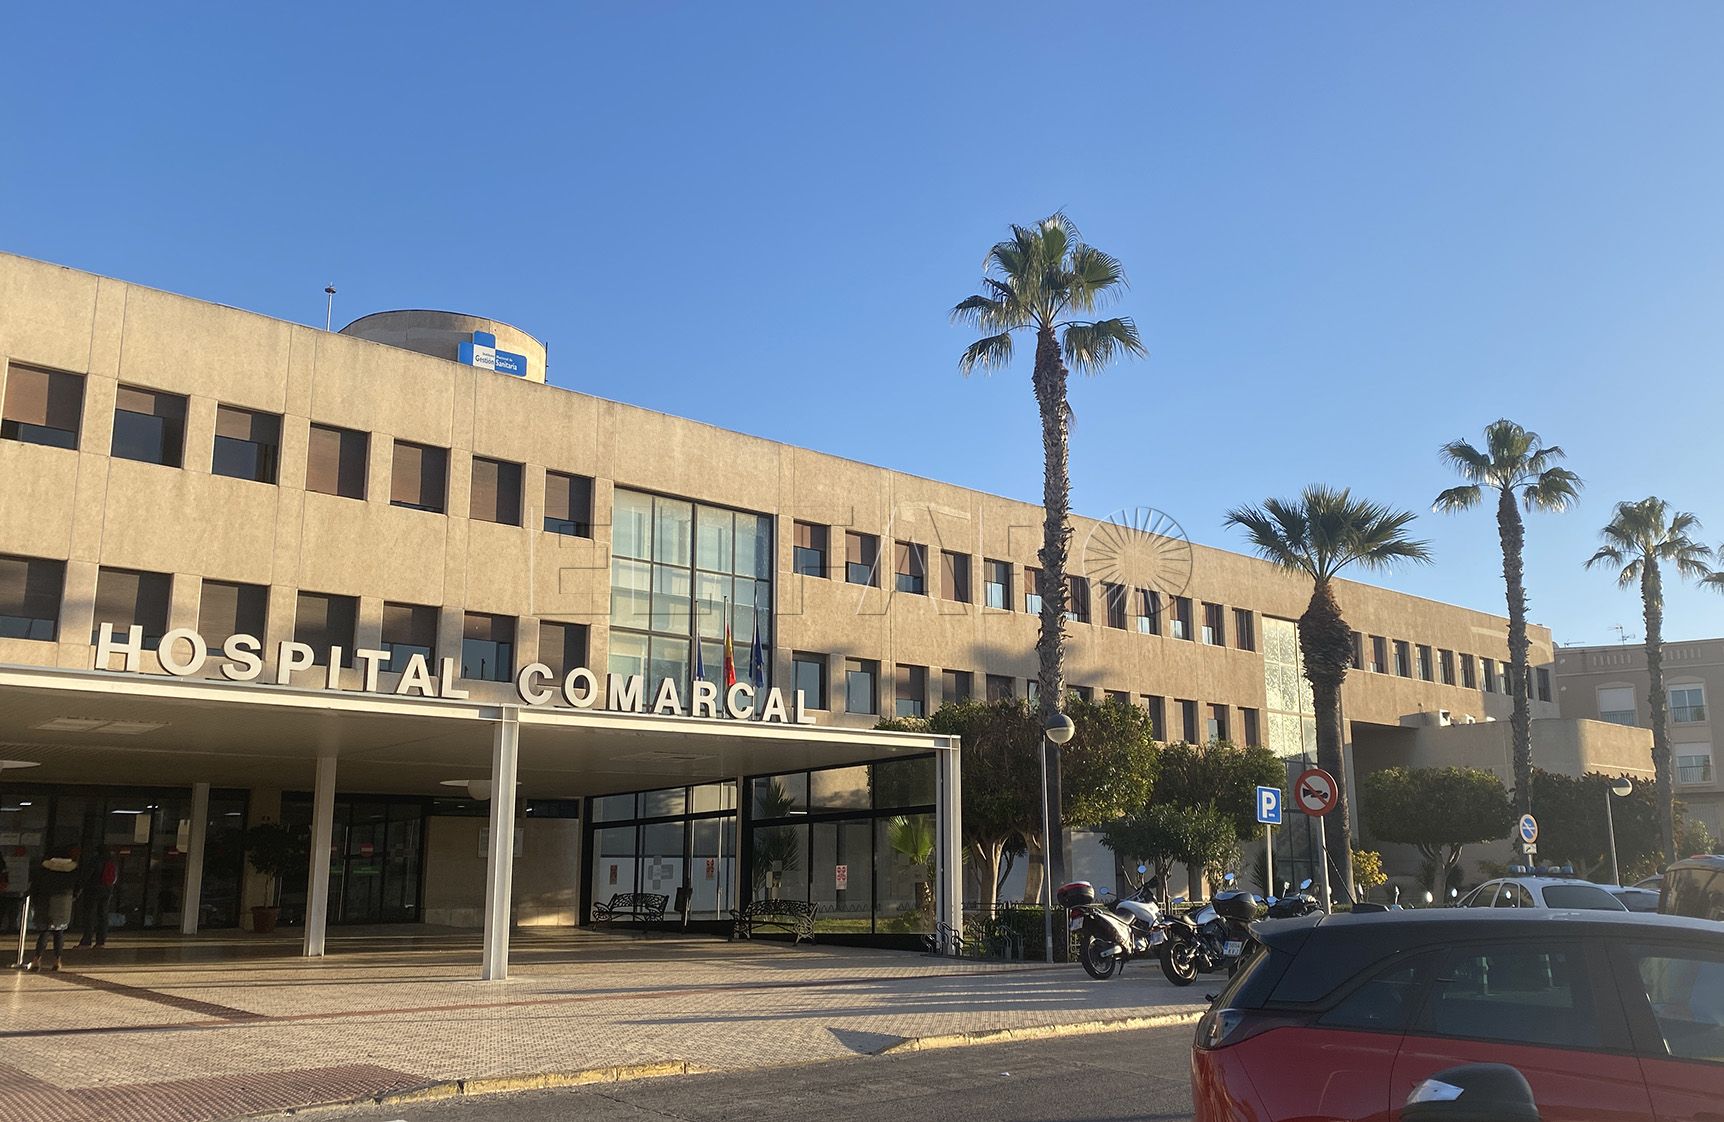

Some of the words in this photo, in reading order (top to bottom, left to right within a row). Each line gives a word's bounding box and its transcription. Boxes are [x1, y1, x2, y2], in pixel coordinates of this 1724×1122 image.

[495, 359, 517, 371] Sanitaria
[94, 622, 469, 699] HOSPITAL
[516, 662, 817, 724] COMARCAL
[1262, 791, 1276, 818] P
